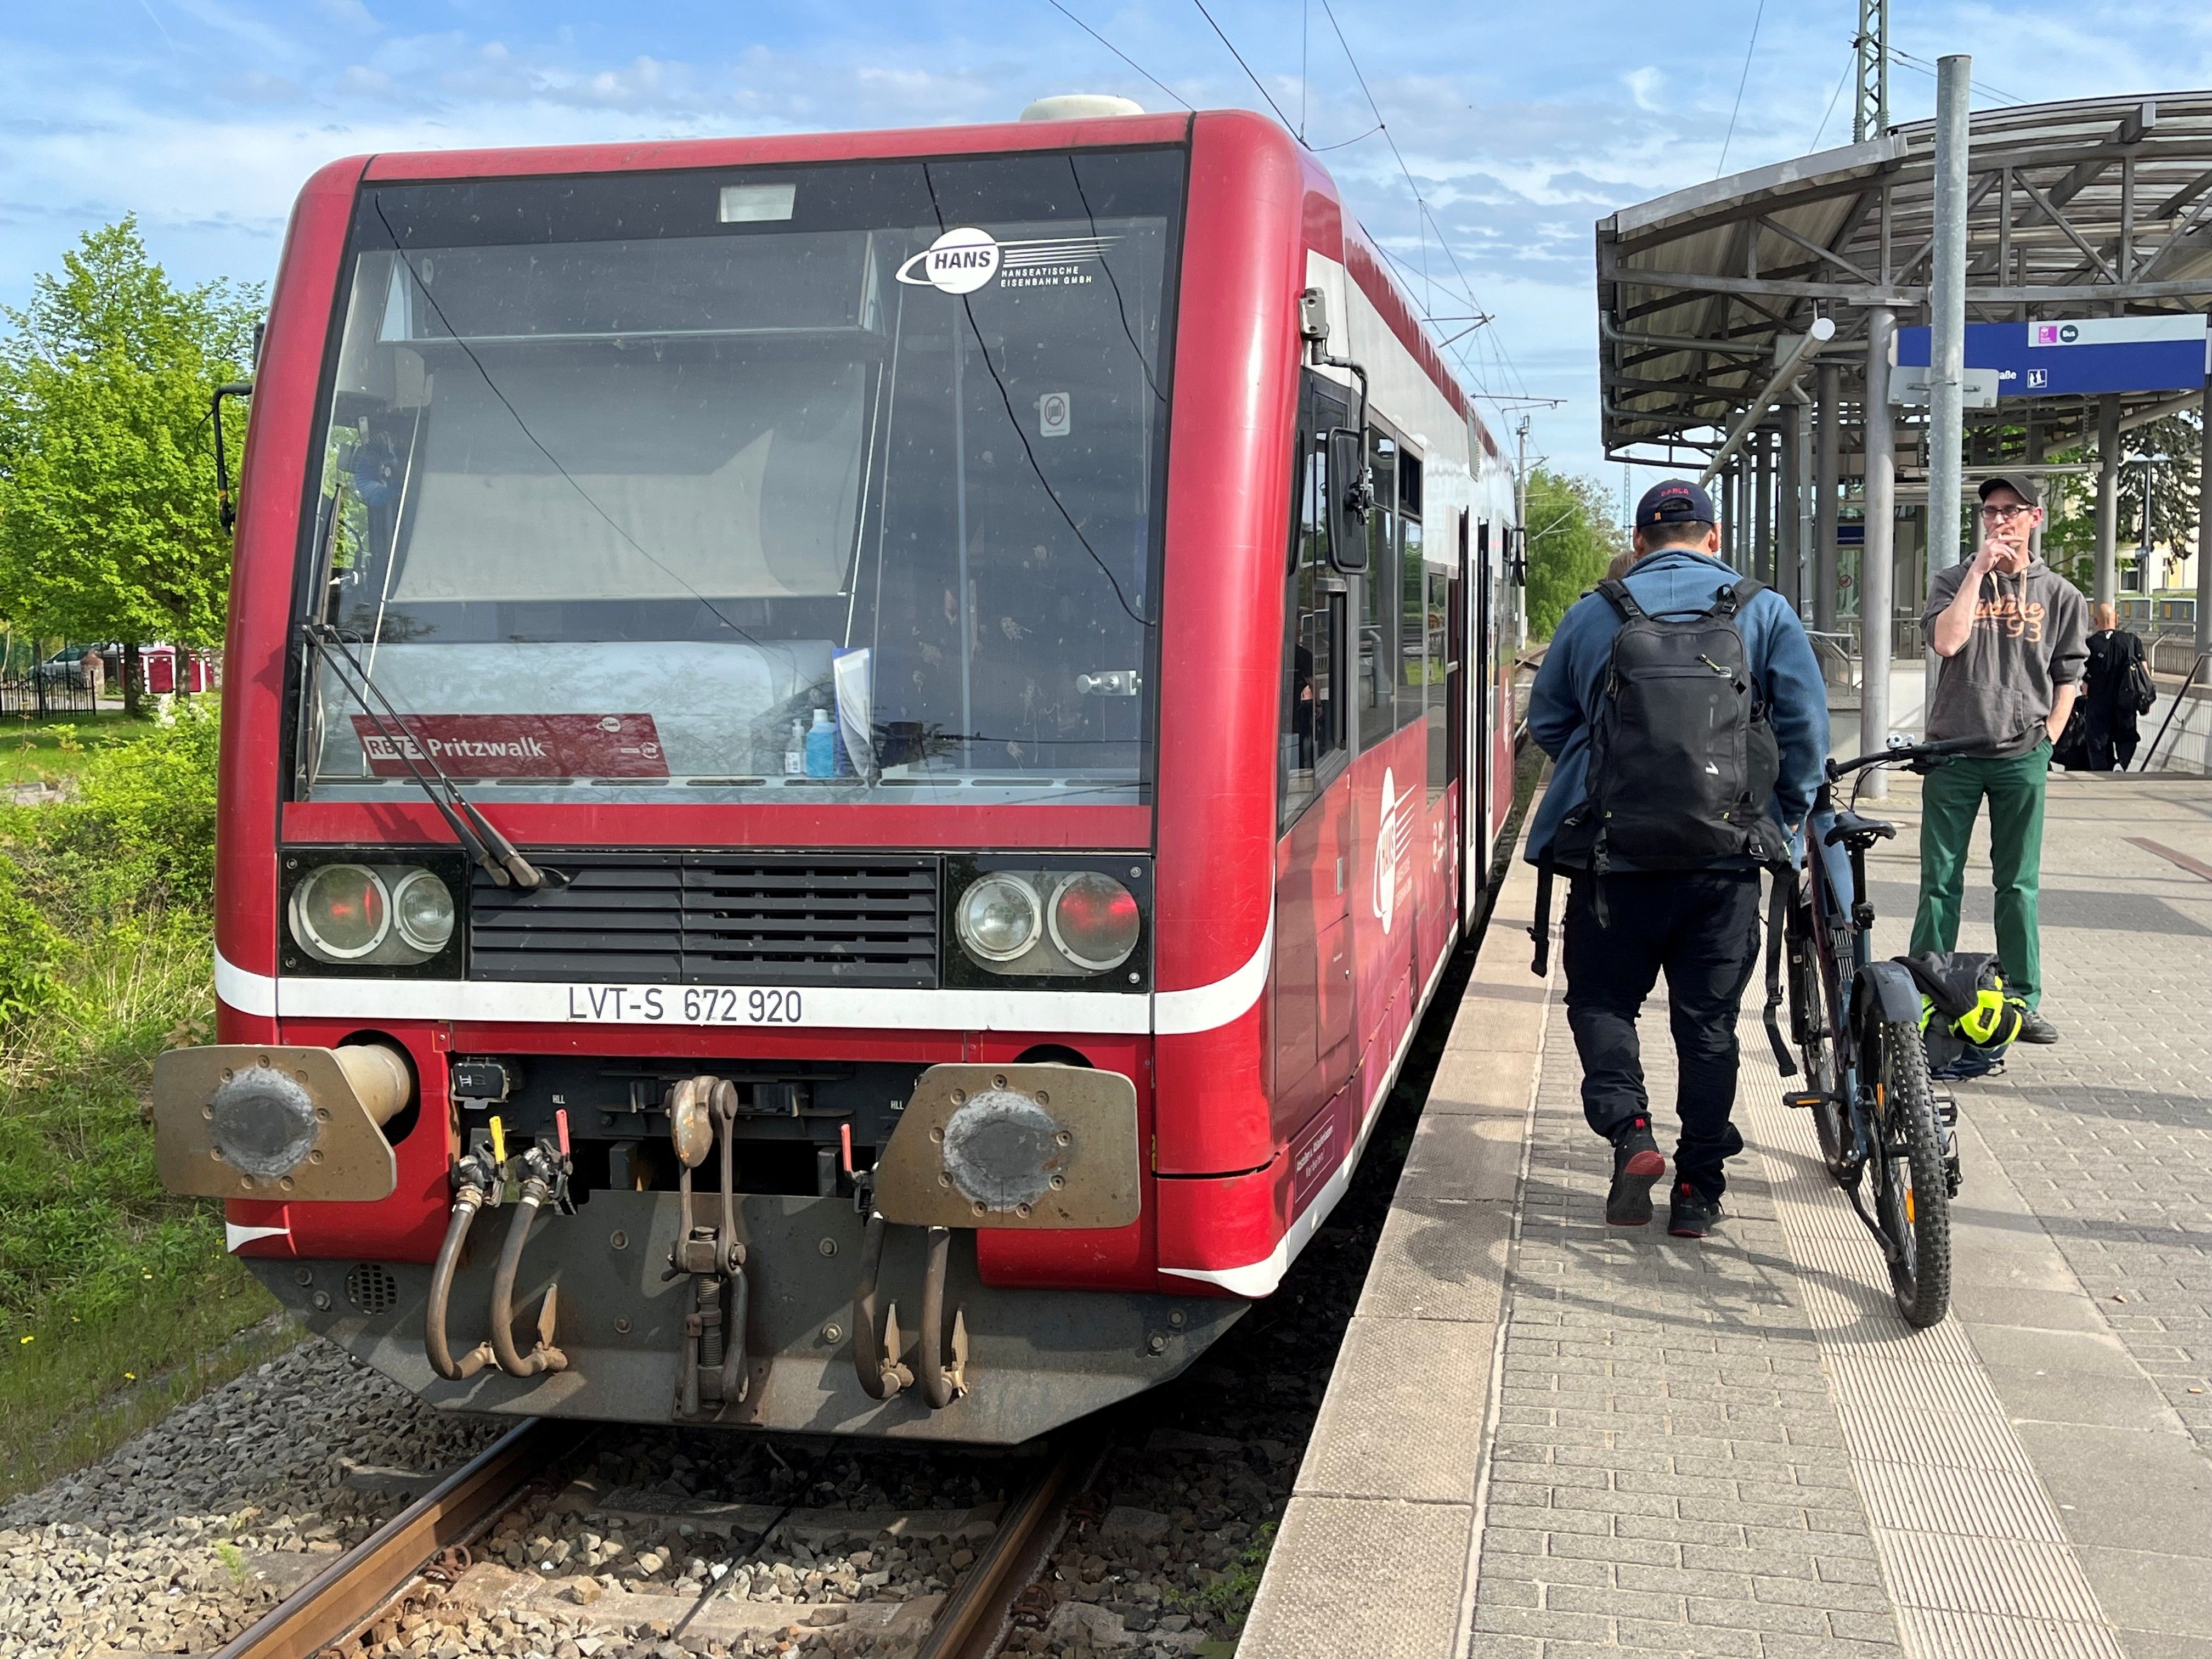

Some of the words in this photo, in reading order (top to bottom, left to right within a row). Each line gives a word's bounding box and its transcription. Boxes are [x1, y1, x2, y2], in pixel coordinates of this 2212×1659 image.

[934, 251, 991, 269] HANS
[1001, 266, 1079, 278] HANSEATISCHE
[1001, 276, 1059, 288] EISENBAHN
[1063, 275, 1093, 285] GMBH
[1999, 370, 2017, 380] aße
[427, 737, 547, 757] Pritzwalk
[569, 986, 664, 1020] LVT-S
[684, 988, 737, 1022] 672
[748, 990, 802, 1023] 920
